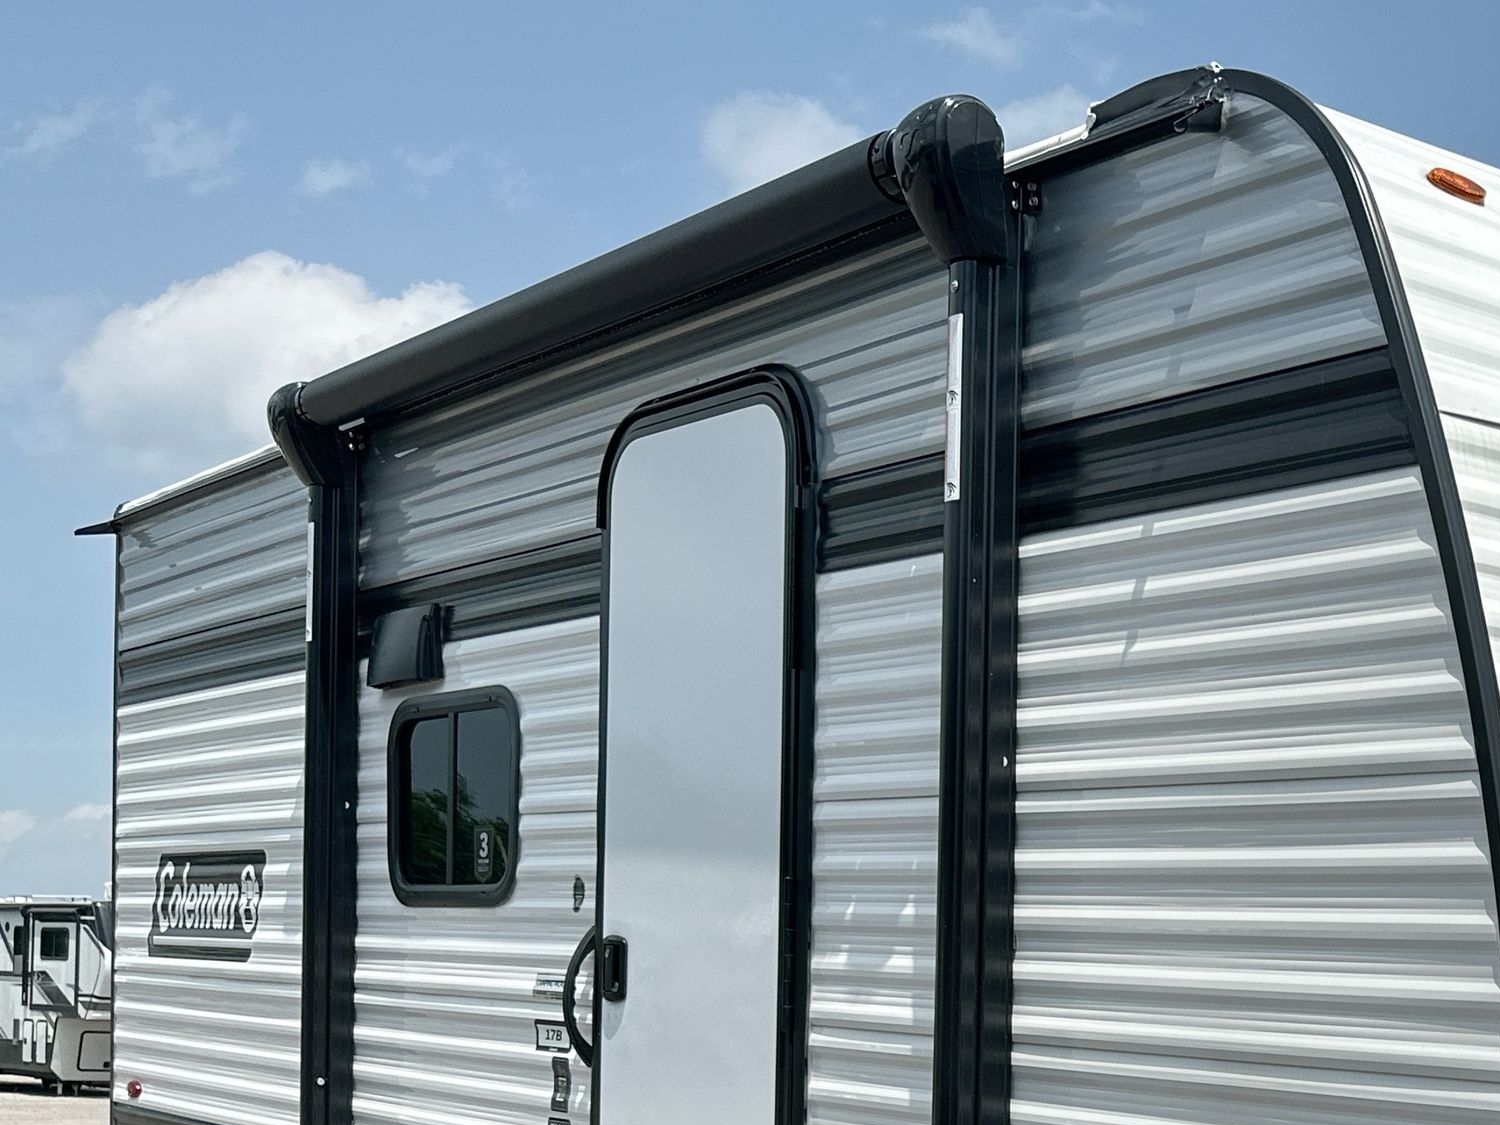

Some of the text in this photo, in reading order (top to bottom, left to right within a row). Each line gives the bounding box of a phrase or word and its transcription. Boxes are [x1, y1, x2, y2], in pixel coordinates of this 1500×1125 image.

[479, 832, 489, 858] 3
[158, 861, 239, 933] Coleman
[545, 1029, 563, 1042] 17B
